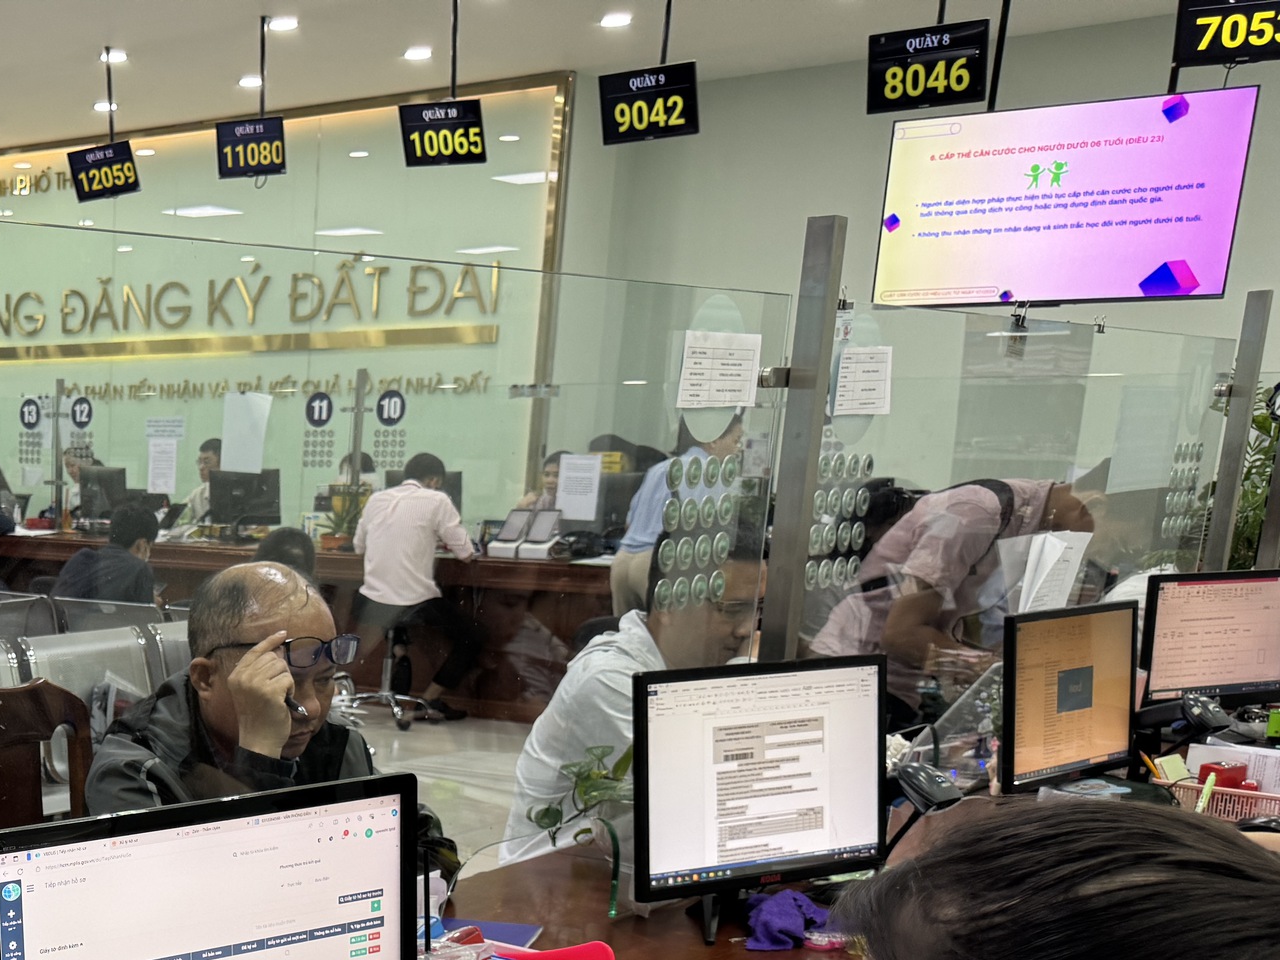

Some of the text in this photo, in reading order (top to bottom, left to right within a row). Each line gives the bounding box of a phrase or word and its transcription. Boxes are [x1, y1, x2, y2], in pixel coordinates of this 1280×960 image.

[906, 33, 951, 53] QUẦY 8
[629, 73, 666, 91] QUẦY 9
[884, 57, 970, 100] 8046
[614, 95, 686, 133] 9042
[222, 140, 282, 168] 11080
[410, 127, 482, 158] 10065
[78, 162, 136, 193] 12059
[60, 276, 192, 334] ĐĂNG
[207, 262, 271, 327] KÝ
[289, 251, 390, 323] ĐẤT
[407, 260, 501, 317] ĐAI
[159, 379, 204, 403] NHẬN
[405, 373, 444, 395] NHÀ
[22, 403, 39, 424] 13
[74, 403, 90, 423] 12
[310, 400, 328, 420] 11
[379, 397, 401, 419] 10
